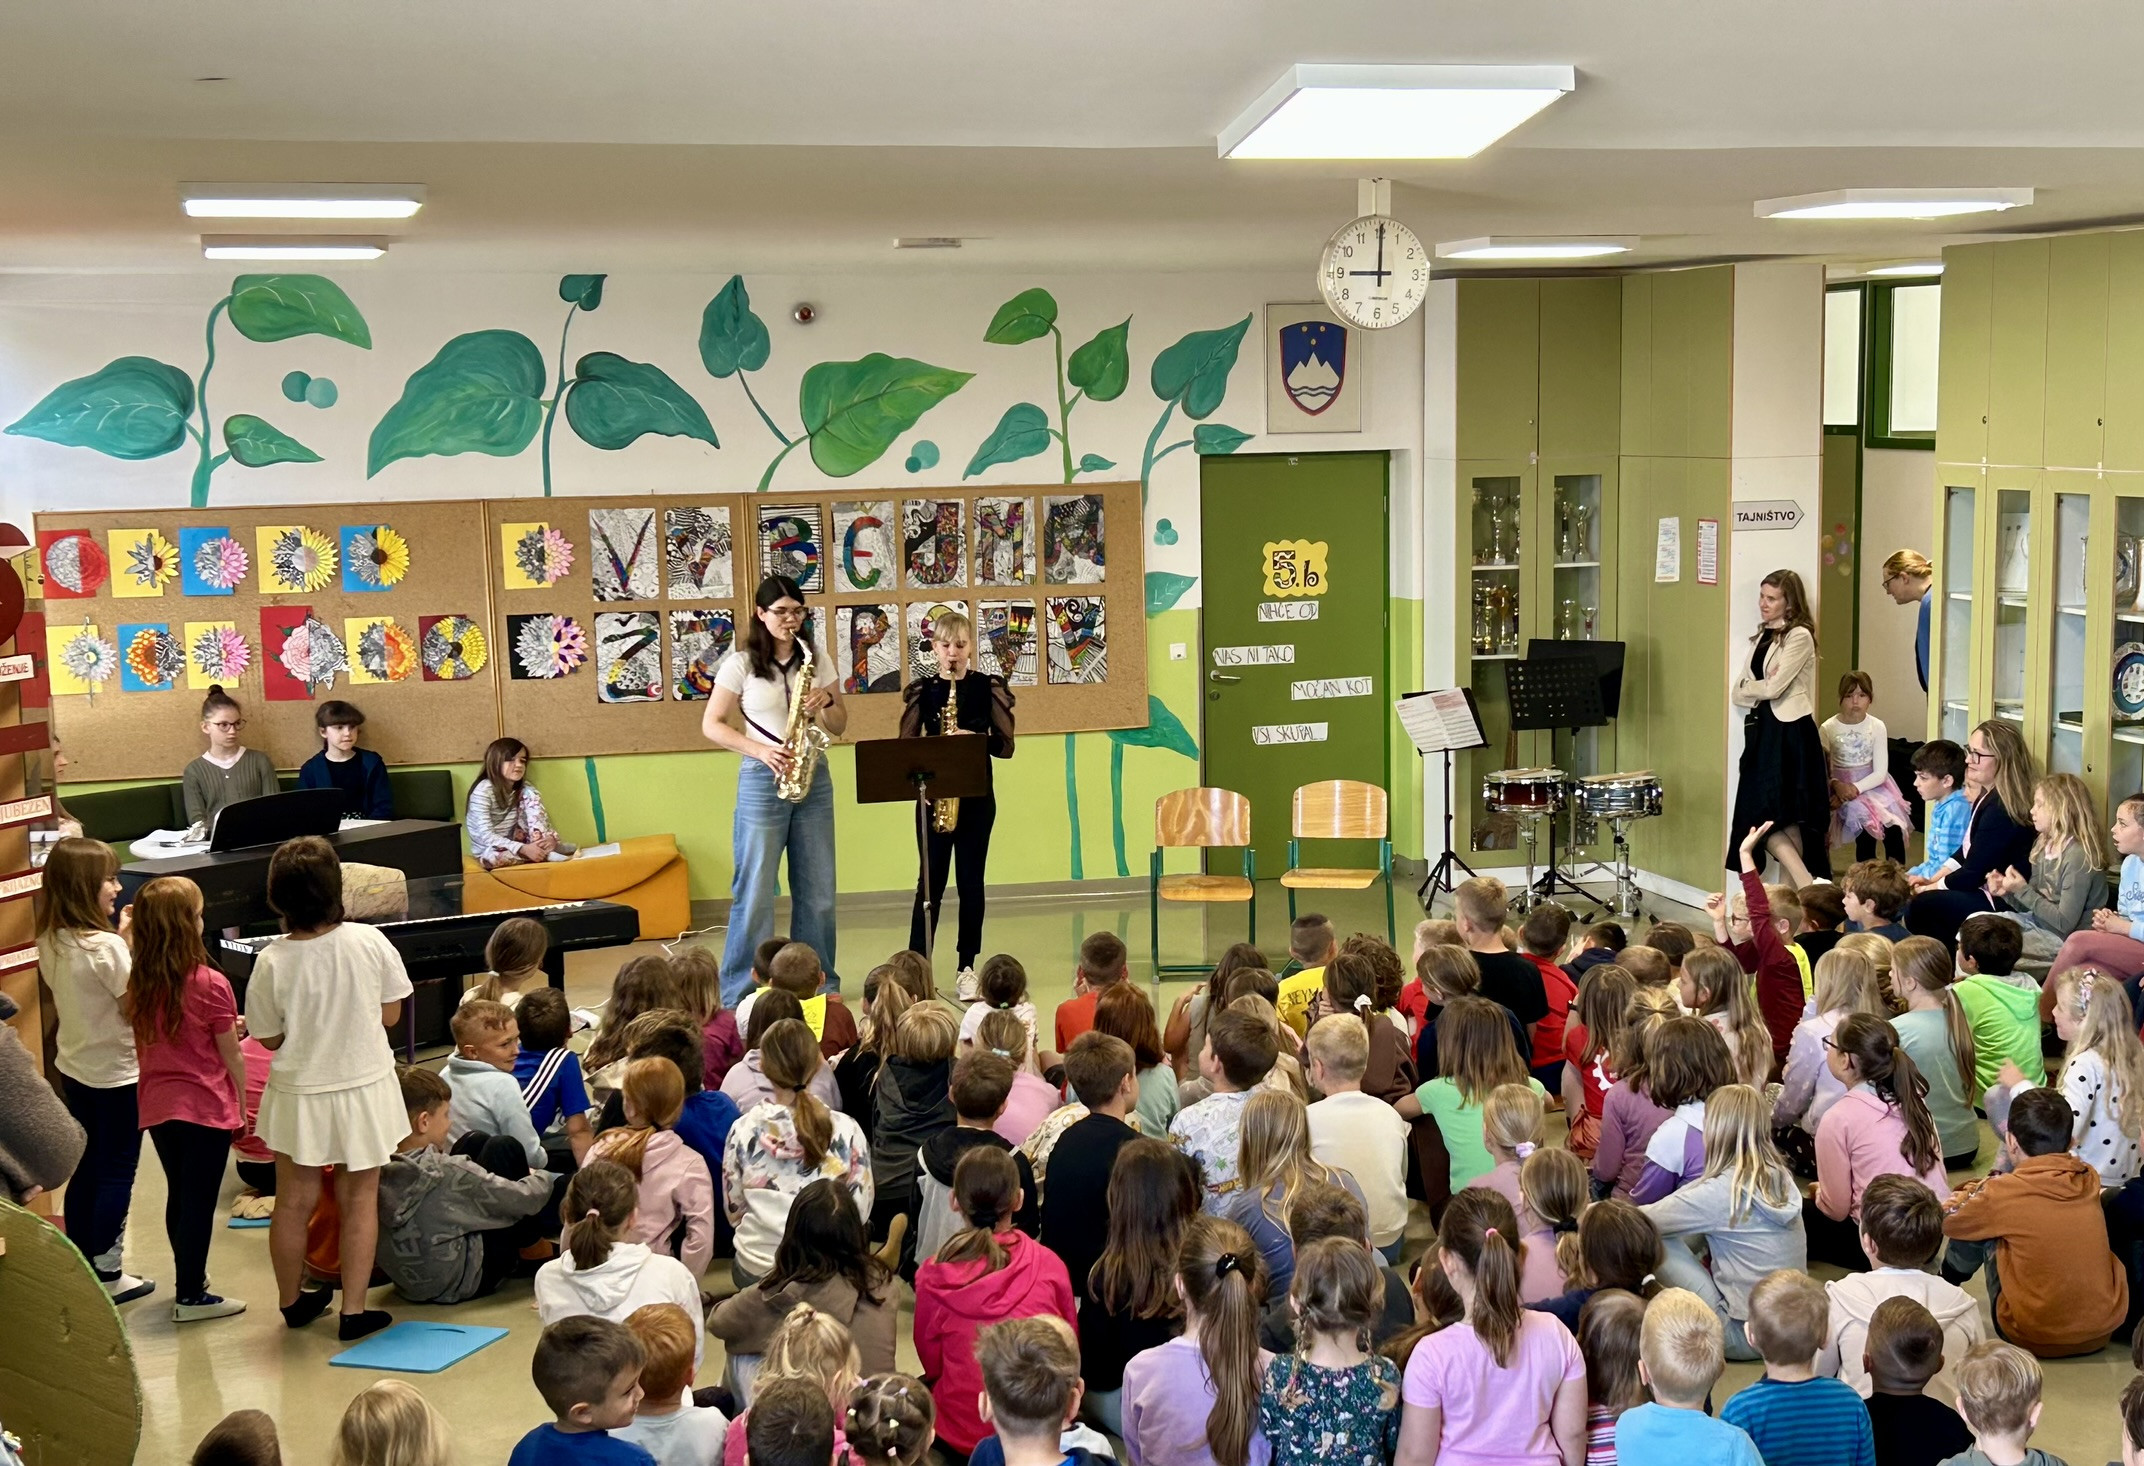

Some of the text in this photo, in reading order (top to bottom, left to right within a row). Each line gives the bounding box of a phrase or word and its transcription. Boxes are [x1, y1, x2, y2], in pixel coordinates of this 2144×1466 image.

[1356, 232, 1366, 244] 11
[1342, 245, 1354, 258] 10
[1406, 247, 1414, 260] 2
[1336, 266, 1345, 279] 9
[1411, 268, 1419, 281] 3
[1341, 288, 1350, 301] 8
[1405, 288, 1413, 300] 4
[1355, 301, 1363, 314] 7
[1373, 307, 1381, 320] 6
[1391, 302, 1400, 315] 5
[1736, 510, 1796, 522] TAJNIŠTVO
[1214, 647, 1242, 664] NAS
[1247, 647, 1259, 663] NI
[1345, 678, 1371, 694] KOT
